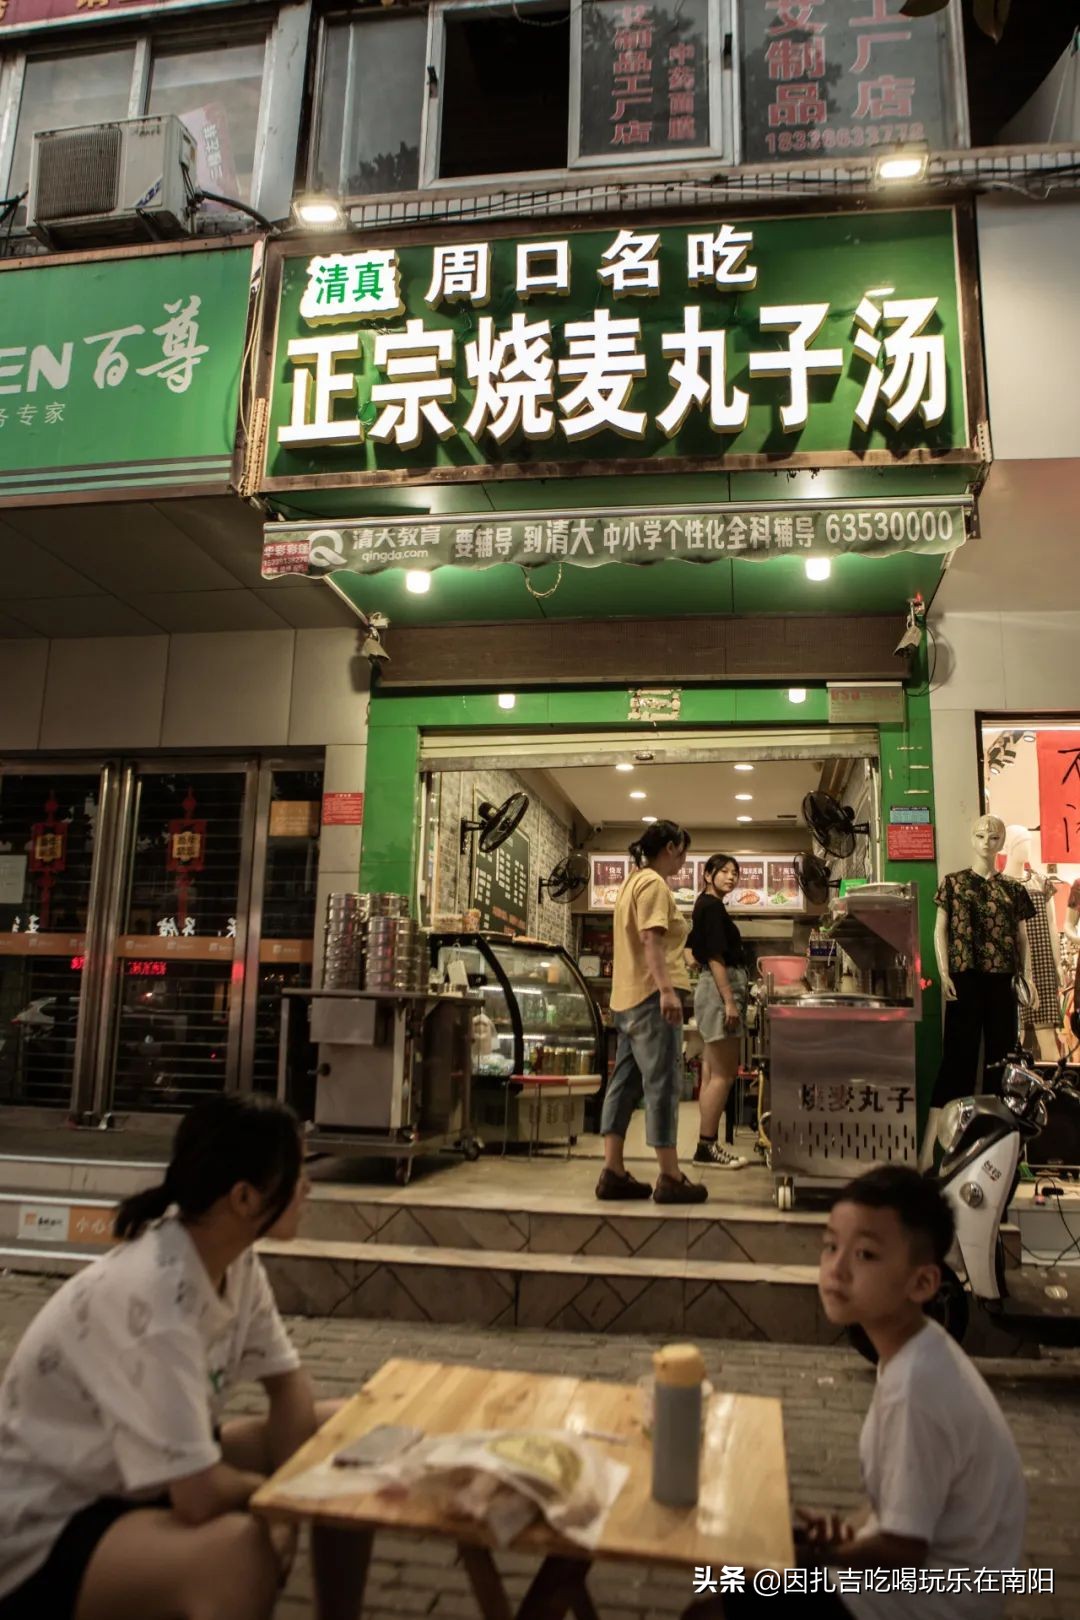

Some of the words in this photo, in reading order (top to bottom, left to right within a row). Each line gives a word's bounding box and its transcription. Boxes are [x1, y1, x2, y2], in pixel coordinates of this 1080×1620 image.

[315, 261, 385, 304] 清真
[425, 224, 758, 306] 周口名吃
[83, 295, 210, 393] 百尊
[277, 295, 948, 448] 正宗烧麦丸子汤
[353, 525, 440, 549] 清大教育
[455, 526, 513, 558] 要辅导
[523, 519, 594, 555] 到清大
[603, 515, 815, 554] 中小学个性化全科辅导
[825, 510, 953, 544] 63530000
[361, 549, 429, 563] qingda.com
